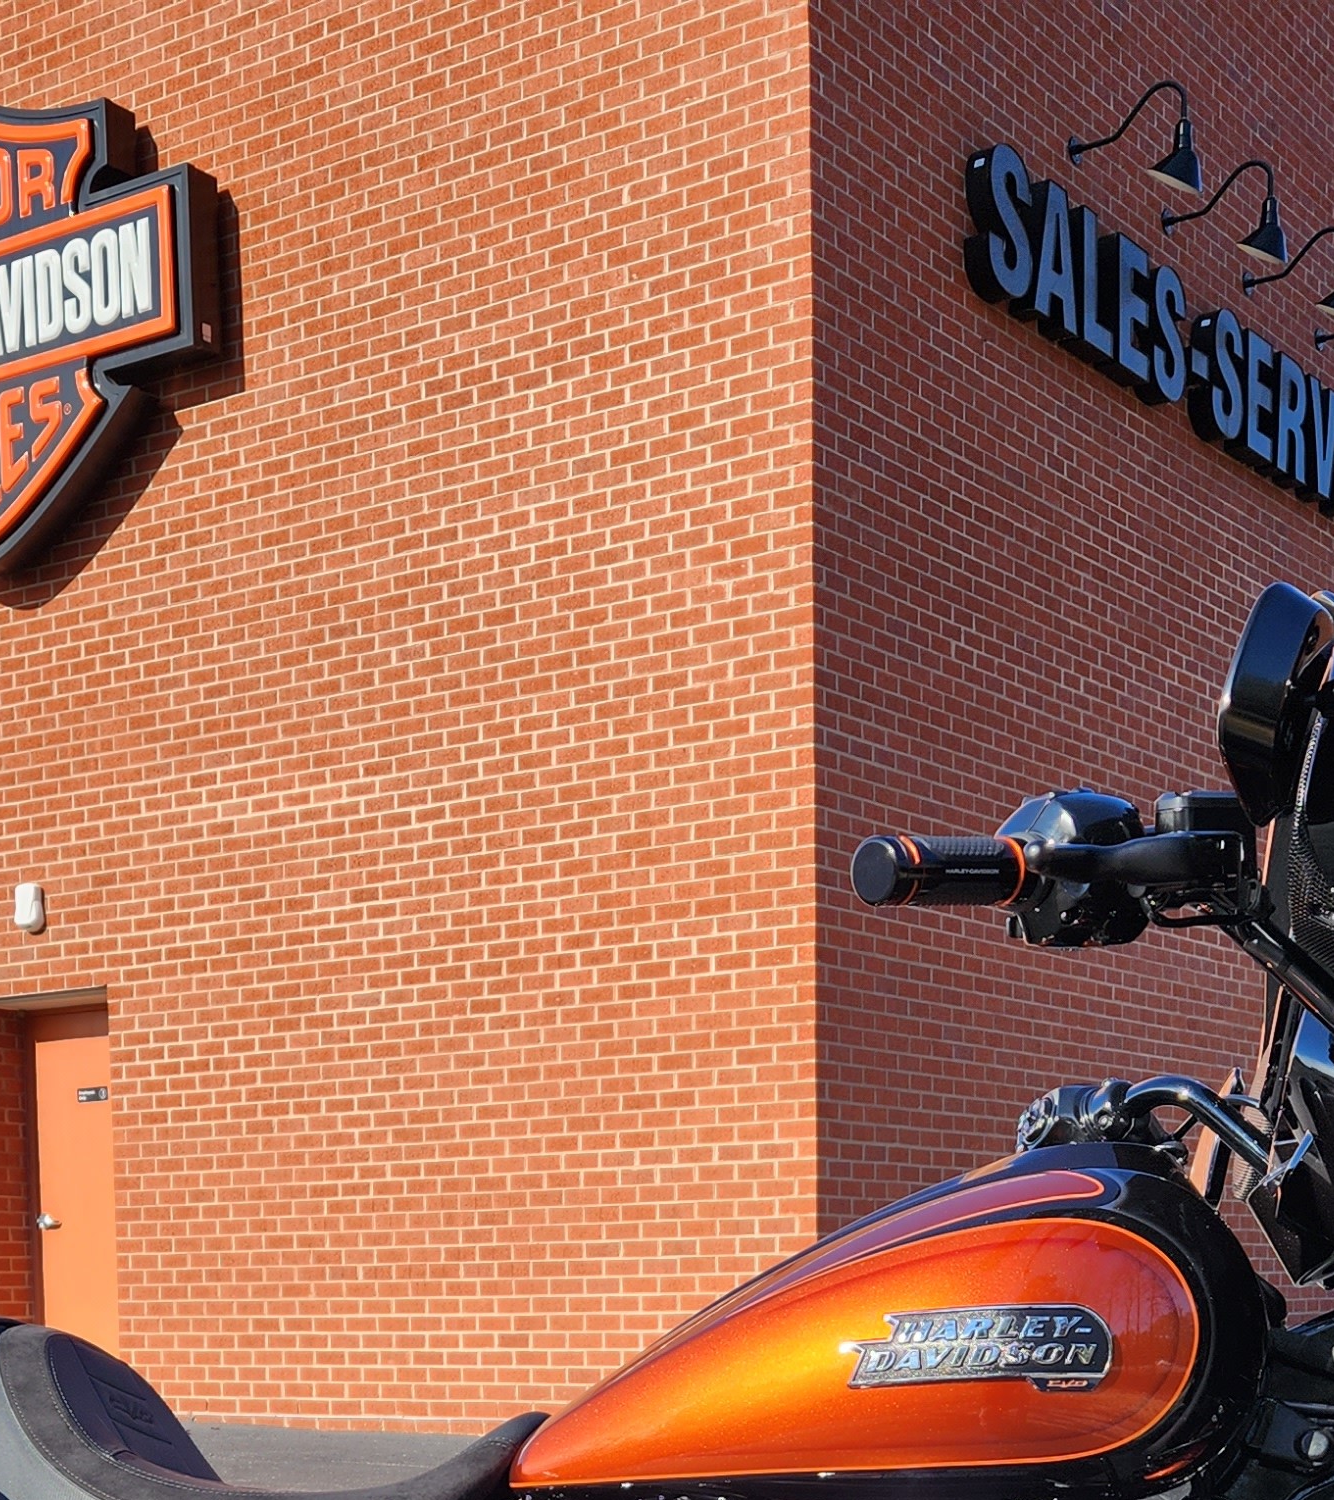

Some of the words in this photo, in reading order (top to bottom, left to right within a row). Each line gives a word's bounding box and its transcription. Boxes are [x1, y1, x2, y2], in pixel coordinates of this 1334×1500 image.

[898, 1314, 1092, 1344] HARLEY-
[865, 1342, 1098, 1373] DAVIDSON
[1046, 1379, 1089, 1389] CVO
